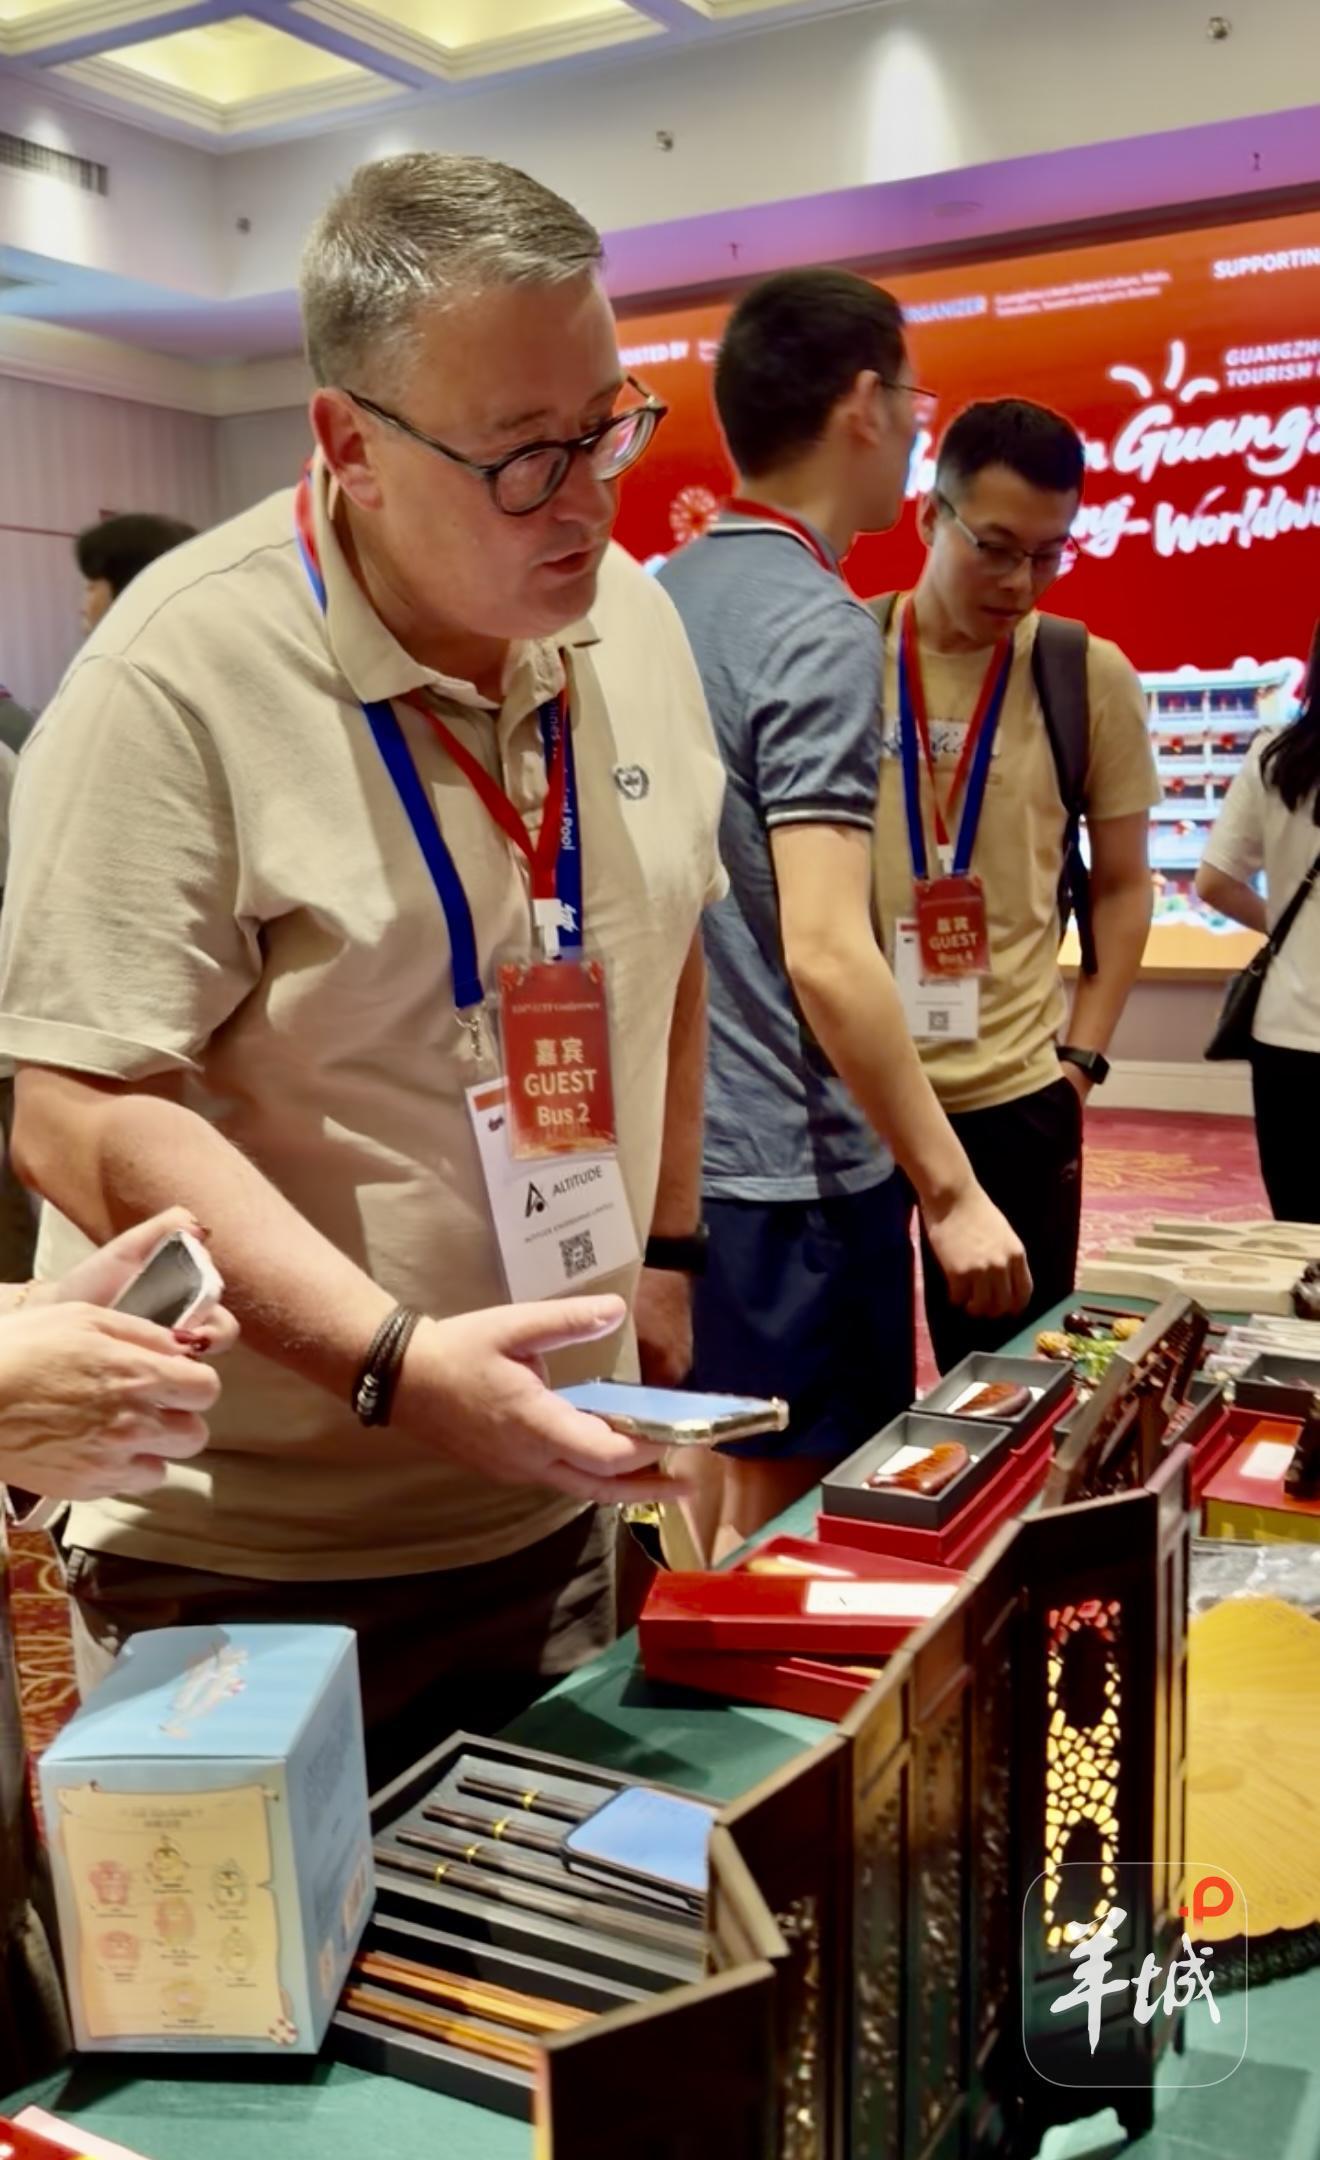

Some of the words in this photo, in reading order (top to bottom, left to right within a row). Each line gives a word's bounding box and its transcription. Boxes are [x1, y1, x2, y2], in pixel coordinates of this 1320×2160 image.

[902, 295, 987, 324] RGANIZER
[1225, 339, 1320, 367] GUANGZH
[1226, 360, 1313, 387] TOURISM
[928, 931, 977, 952] GUEST
[535, 1037, 584, 1067] 嘉宾
[523, 1068, 598, 1097] GUEST
[536, 1105, 575, 1128] Bus
[577, 1102, 592, 1124] 2
[552, 1164, 603, 1197] ALTITUDE
